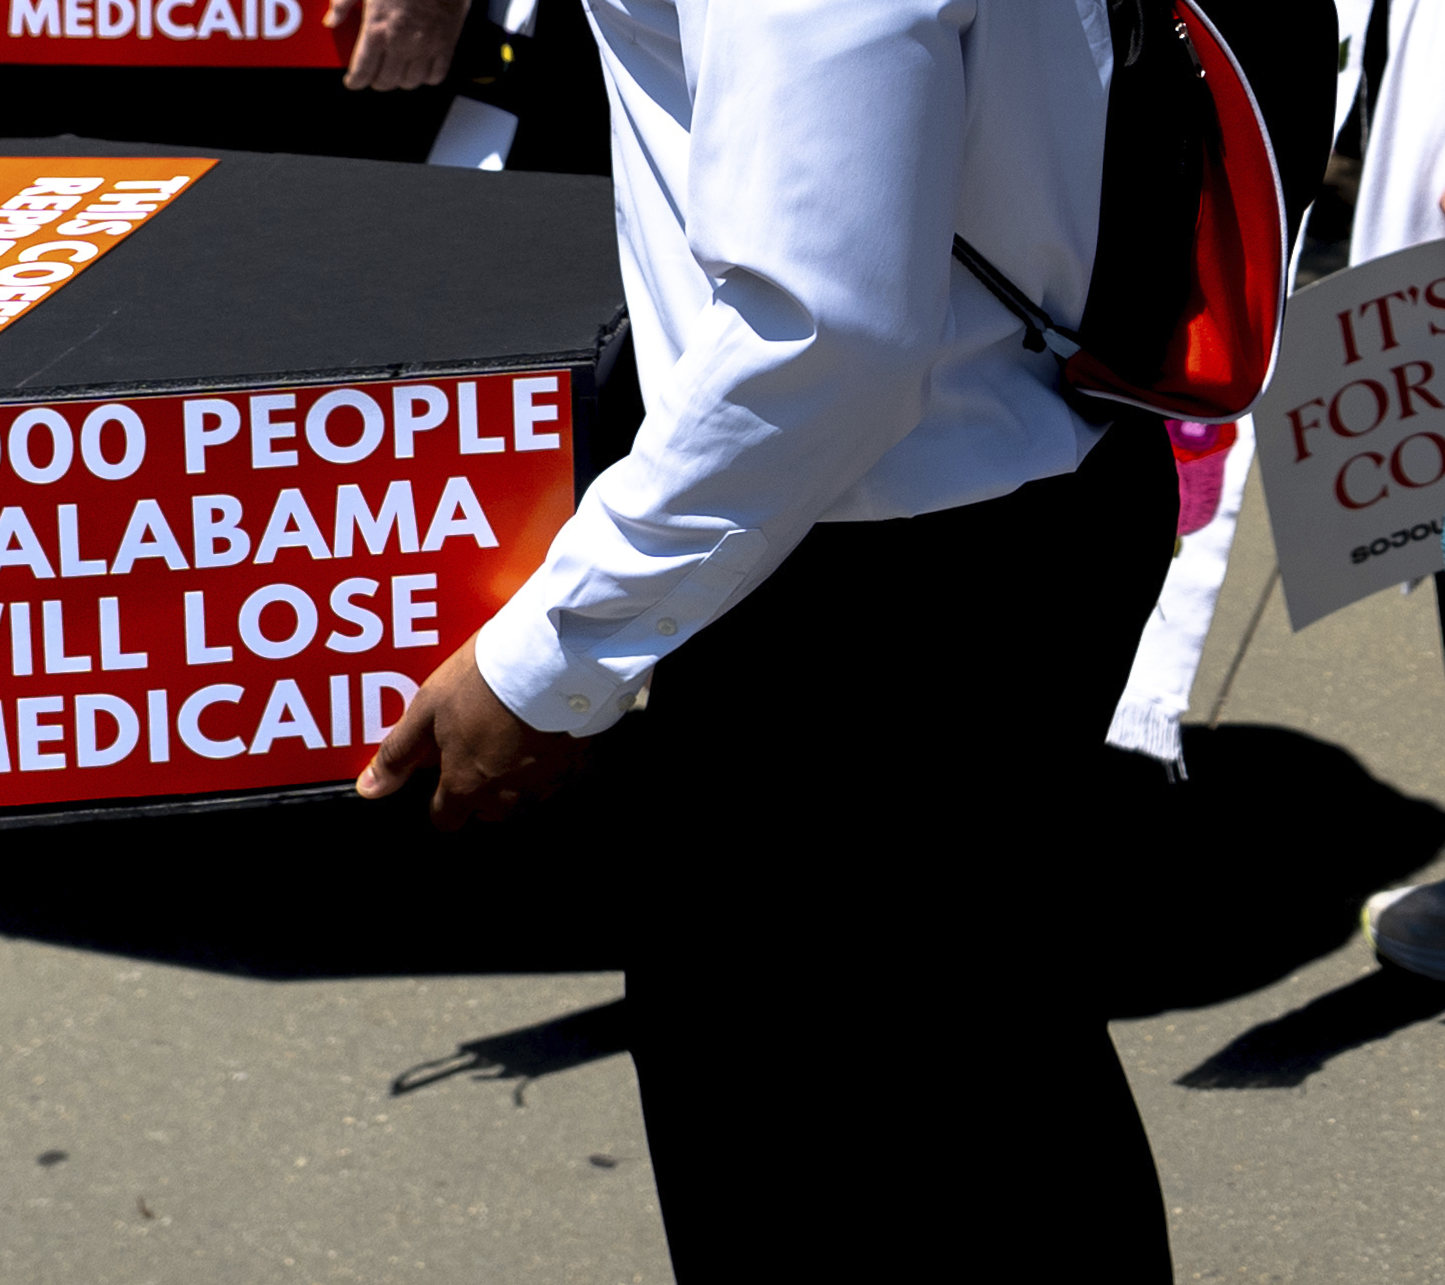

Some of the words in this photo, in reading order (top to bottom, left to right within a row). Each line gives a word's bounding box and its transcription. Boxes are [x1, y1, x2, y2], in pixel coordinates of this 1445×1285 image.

[56, 175, 191, 236] THIS
[183, 376, 560, 474] PEOPLE
[184, 573, 438, 665] LOSE
